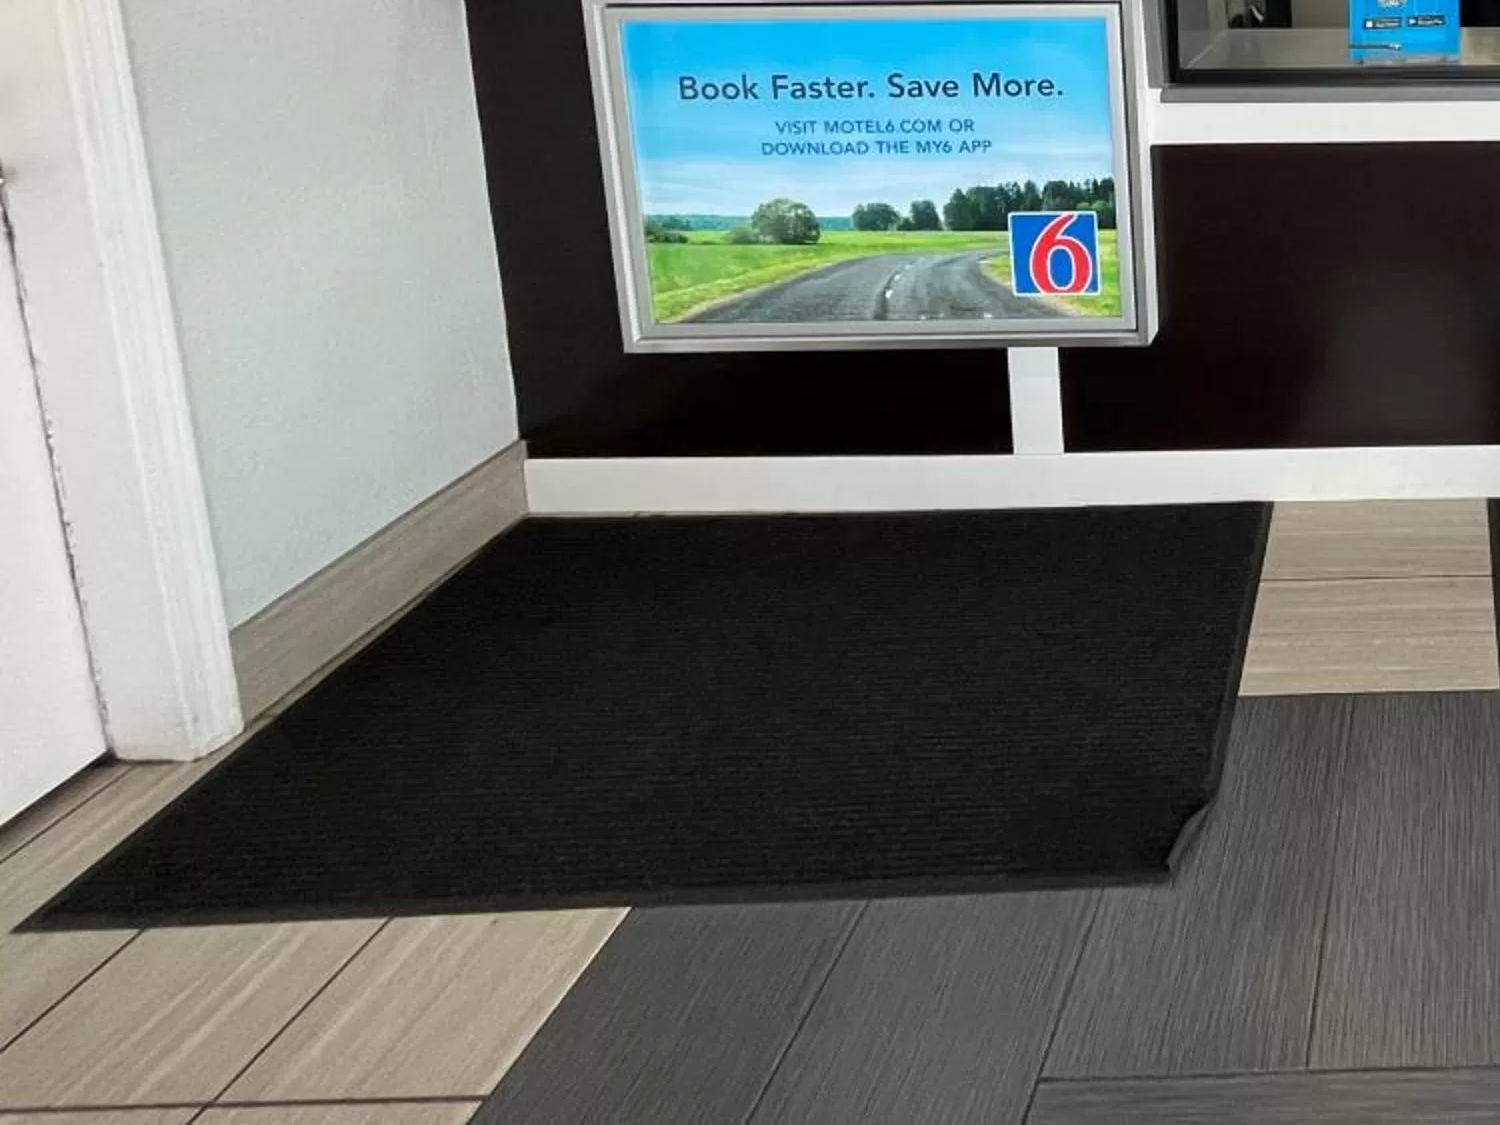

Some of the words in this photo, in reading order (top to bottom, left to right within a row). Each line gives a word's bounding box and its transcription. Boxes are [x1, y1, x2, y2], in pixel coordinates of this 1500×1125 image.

[679, 73, 760, 100] Book
[771, 74, 875, 100] Faster.
[887, 72, 960, 98] Save
[971, 71, 1063, 98] More.
[775, 120, 816, 135] VISIT
[948, 118, 975, 133] OR
[761, 140, 869, 156] DOWNLOAD
[875, 140, 910, 154] THE
[916, 139, 952, 154] MY6
[958, 139, 992, 154] APP
[1029, 211, 1092, 294] 6
